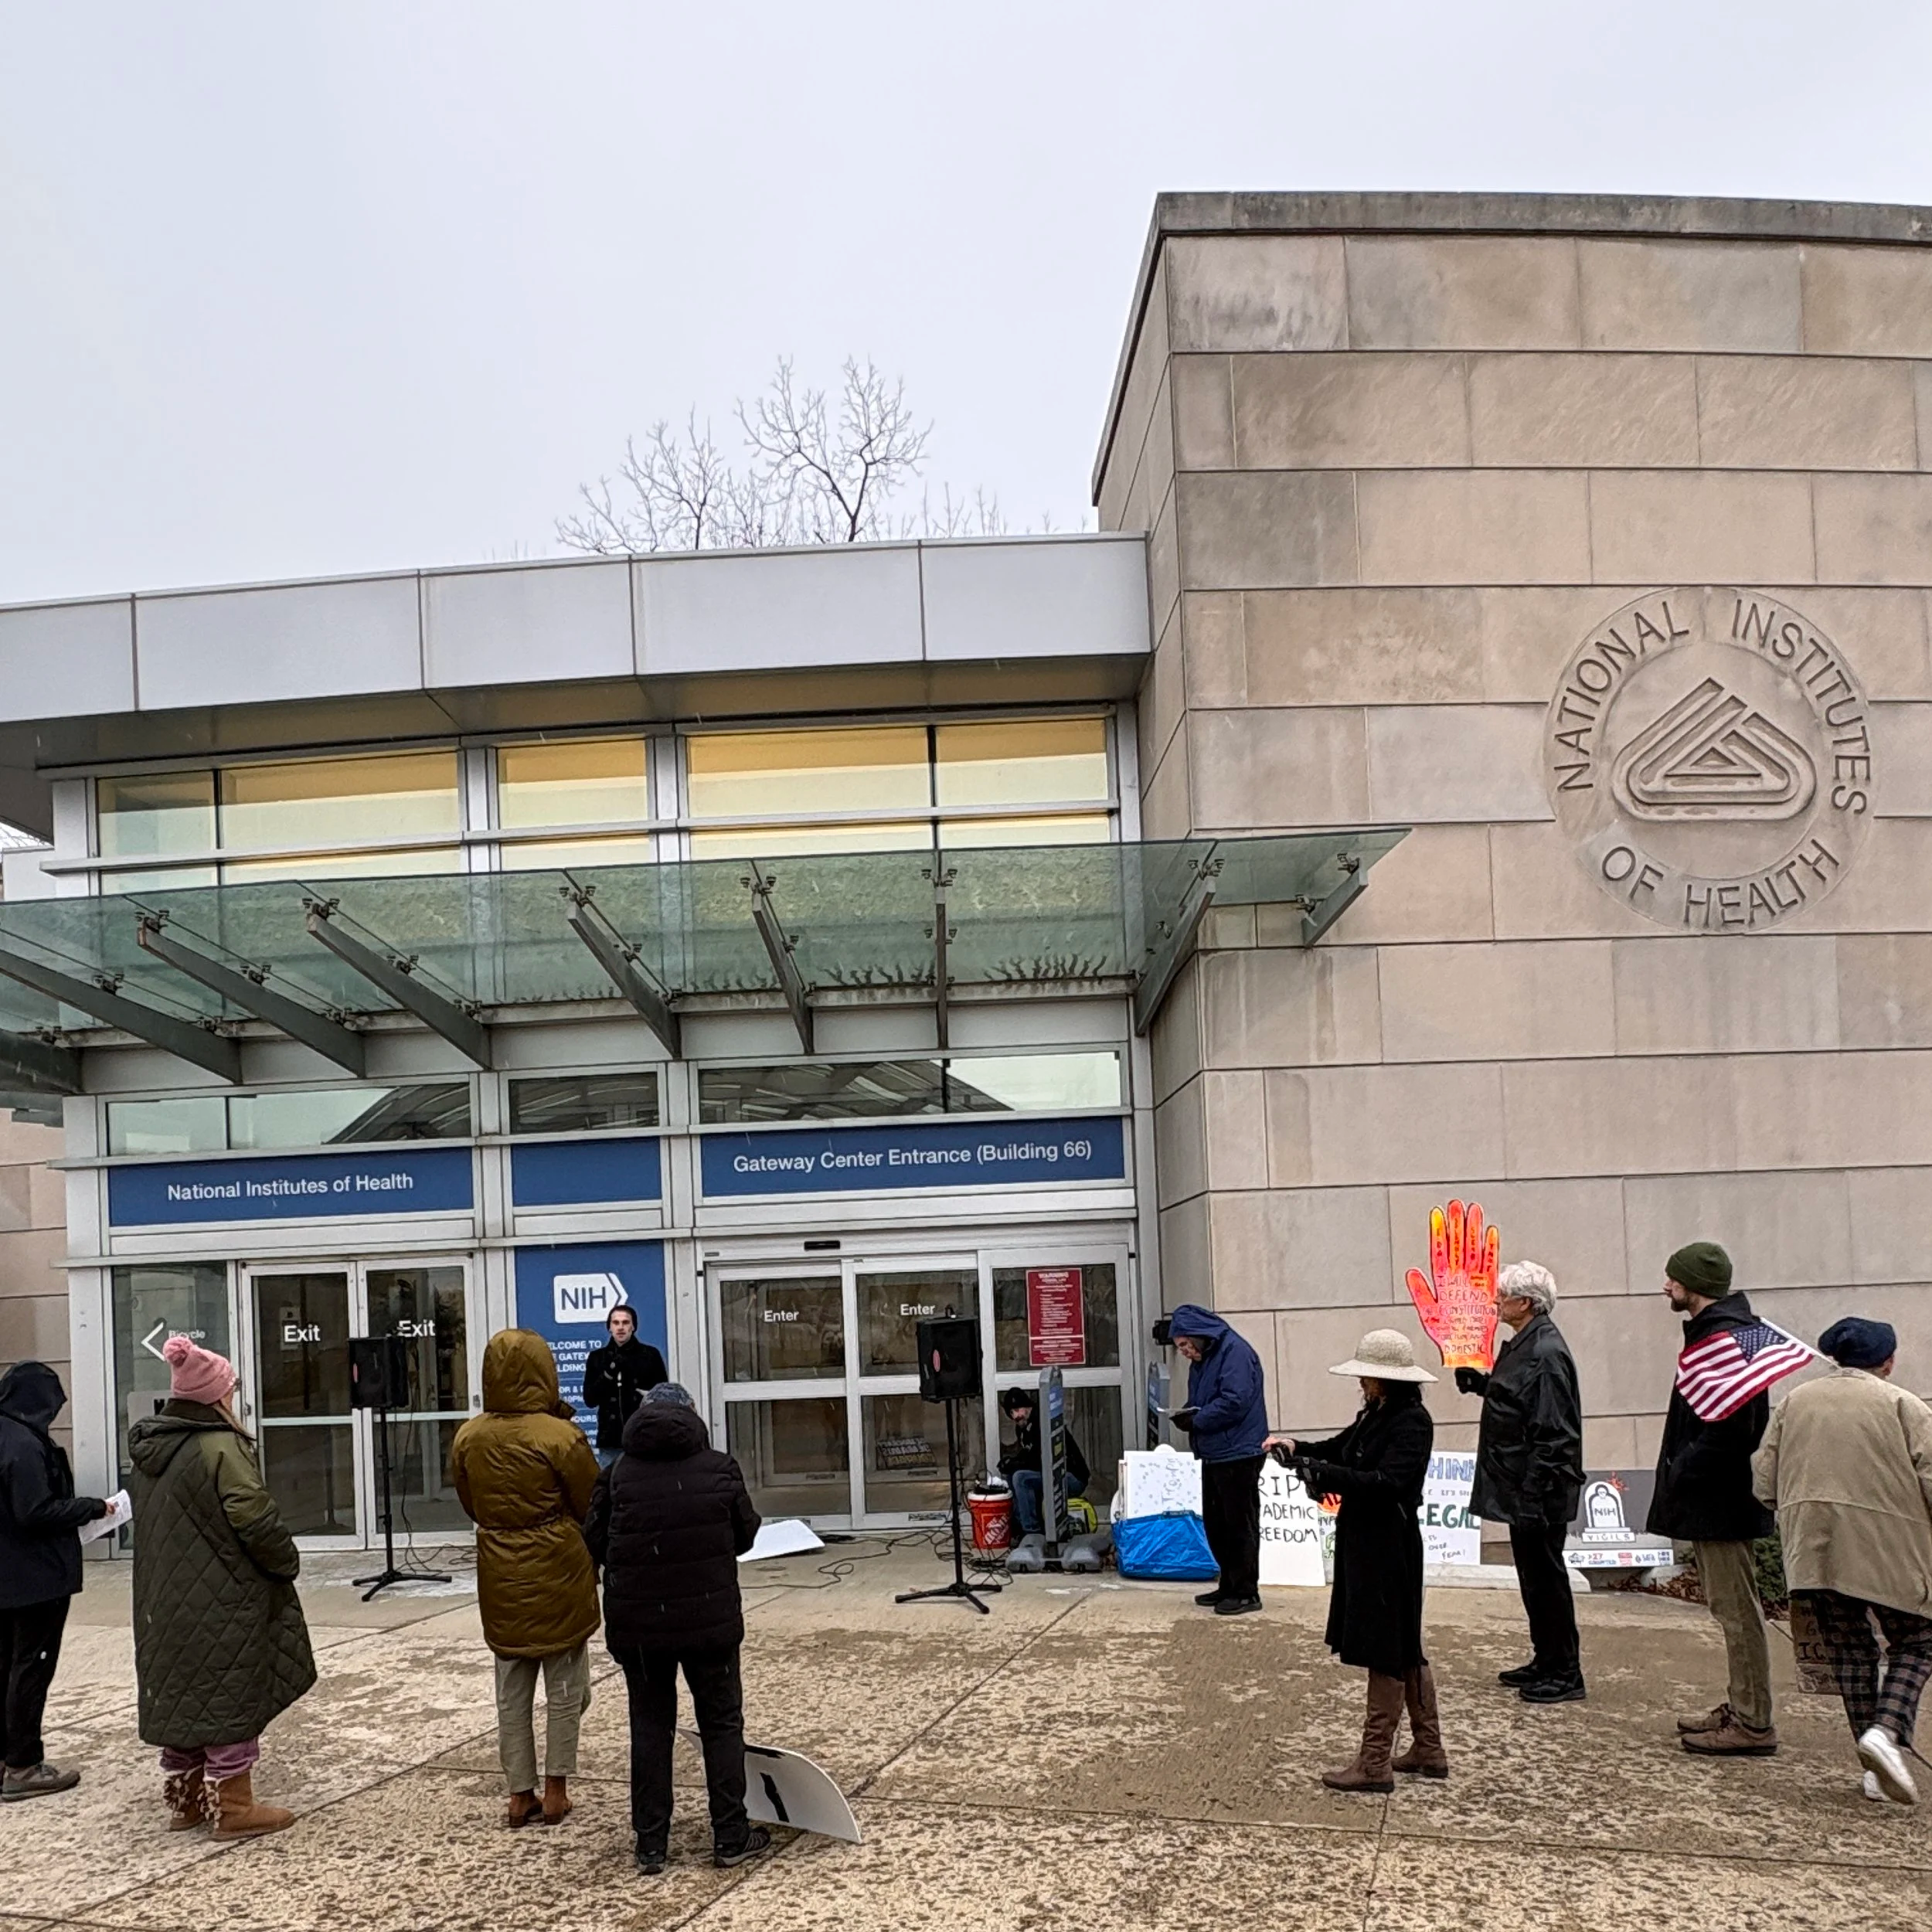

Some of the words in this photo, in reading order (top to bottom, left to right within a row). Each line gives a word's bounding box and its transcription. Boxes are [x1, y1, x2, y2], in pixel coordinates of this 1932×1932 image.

[1554, 600, 1690, 792] NATIONAL
[1731, 599, 1871, 815] INSTITUTES
[1601, 845, 1664, 900] OF
[1683, 838, 1840, 928] HEALTH
[734, 1155, 815, 1174] Gateway
[820, 1151, 883, 1168] Center
[889, 1148, 971, 1165] Entrance
[976, 1143, 1058, 1165] (Building
[1063, 1140, 1091, 1160] 66)
[168, 1181, 240, 1201] National
[246, 1179, 328, 1197] Institutes
[332, 1175, 351, 1192] of
[355, 1173, 413, 1192] Health
[561, 1286, 607, 1310] NIH
[1439, 1289, 1488, 1303] DEFEND
[764, 1309, 800, 1322] Enter
[900, 1303, 936, 1316] Enter
[284, 1324, 321, 1342] Exit
[398, 1319, 436, 1338] Exit
[548, 1342, 587, 1350] LCOME
[588, 1340, 602, 1349] TO
[559, 1352, 590, 1361] GATE
[556, 1363, 586, 1372] LDING
[1257, 1475, 1301, 1498] RIP
[1262, 1503, 1315, 1520] ADEMIC
[1418, 1503, 1480, 1529] EGAL
[1594, 1508, 1617, 1517] NIH
